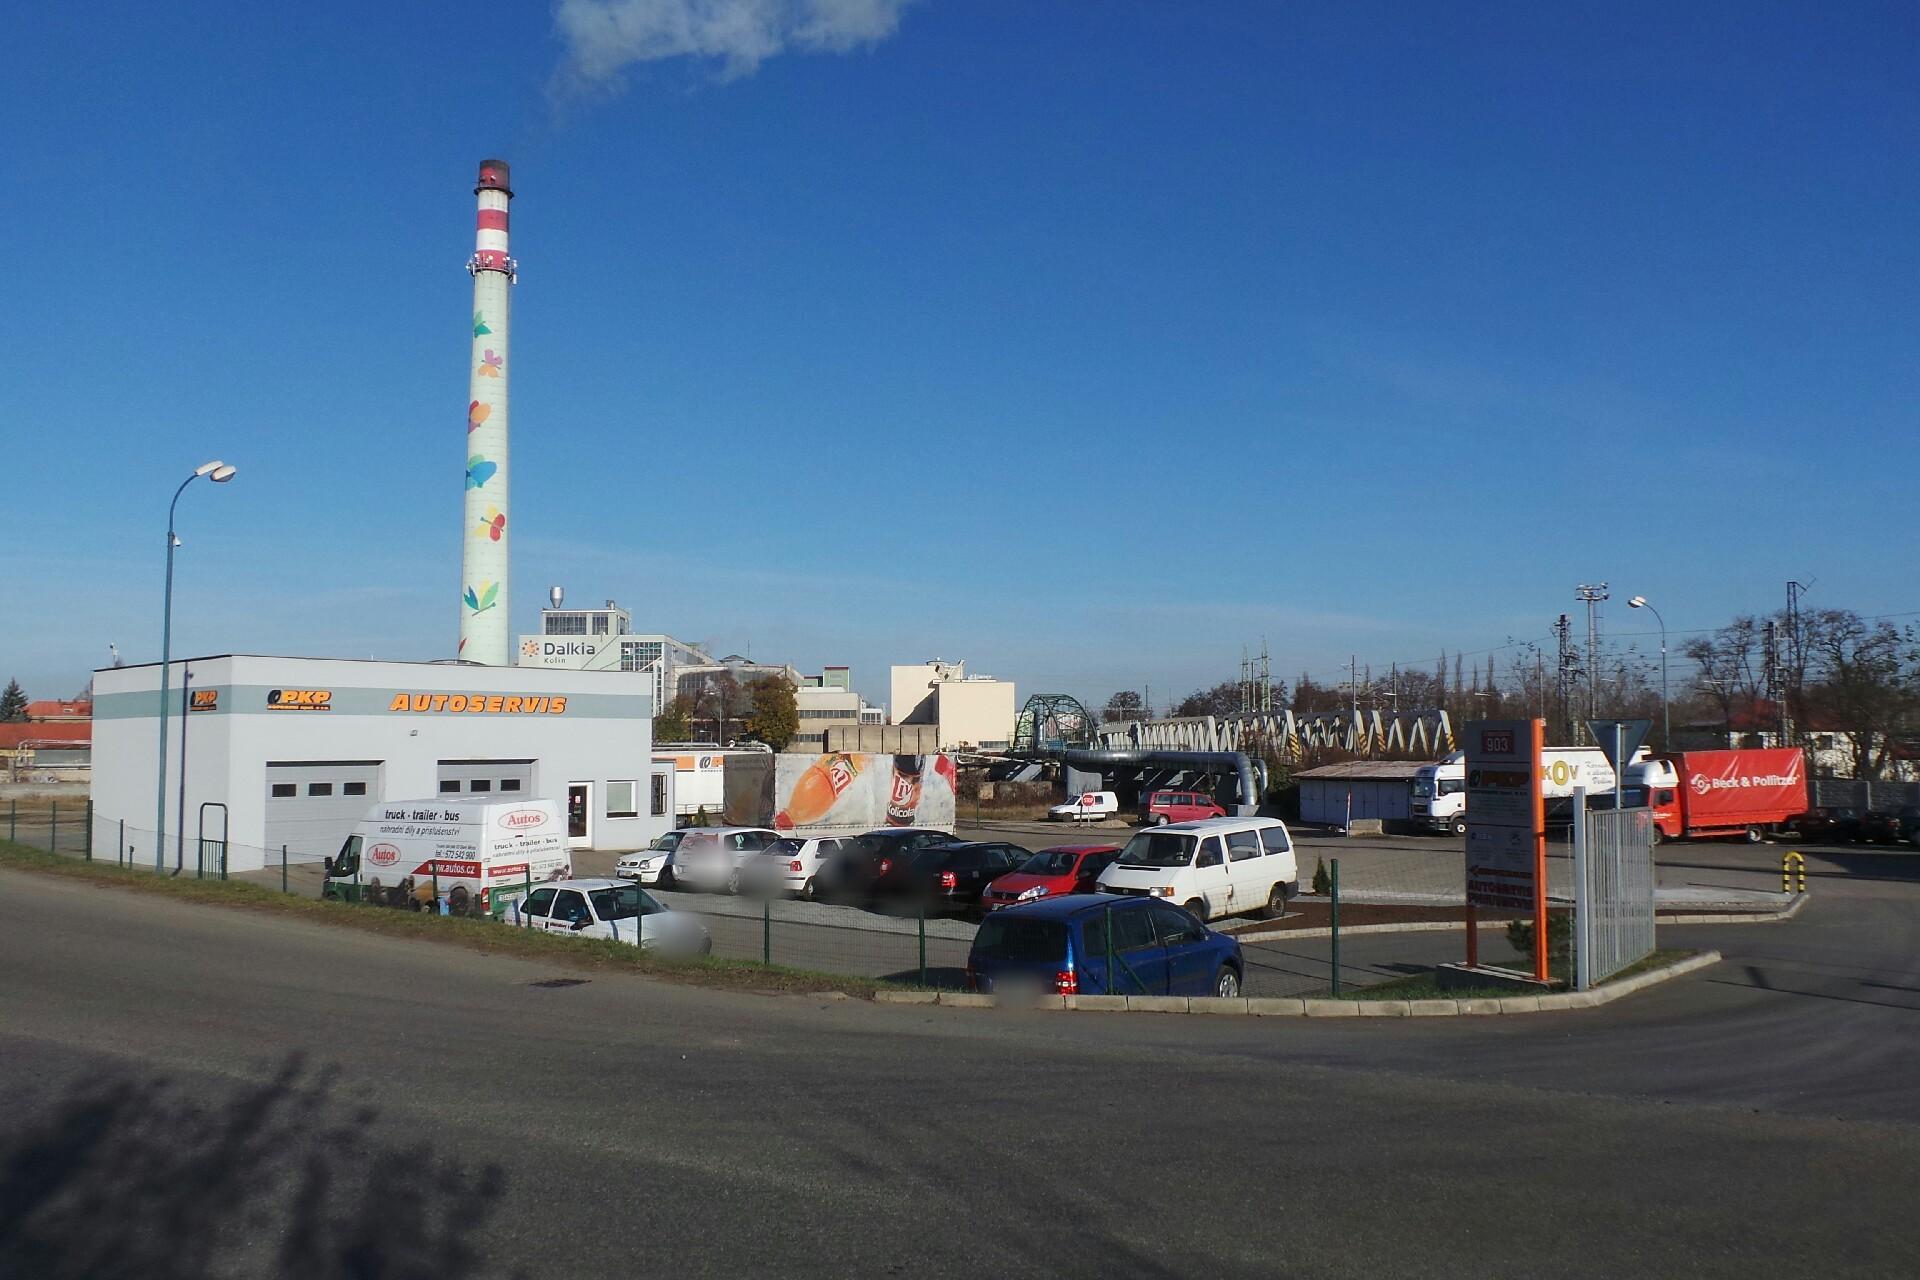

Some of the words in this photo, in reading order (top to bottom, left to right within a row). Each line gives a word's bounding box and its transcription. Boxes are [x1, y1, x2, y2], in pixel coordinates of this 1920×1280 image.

[544, 642, 596, 656] Dalkia
[389, 693, 567, 714] AUTOSERVIS
[1487, 737, 1509, 752] 903
[1712, 777, 1740, 789] Beck
[1741, 776, 1751, 788] &
[1752, 774, 1798, 787] Pollitzer
[385, 809, 405, 820] truck
[412, 808, 437, 821] trailer
[444, 810, 460, 821] bus
[507, 814, 541, 826] Autos
[494, 842, 513, 851] truck
[519, 839, 541, 848] trailer
[371, 847, 396, 861] Autos
